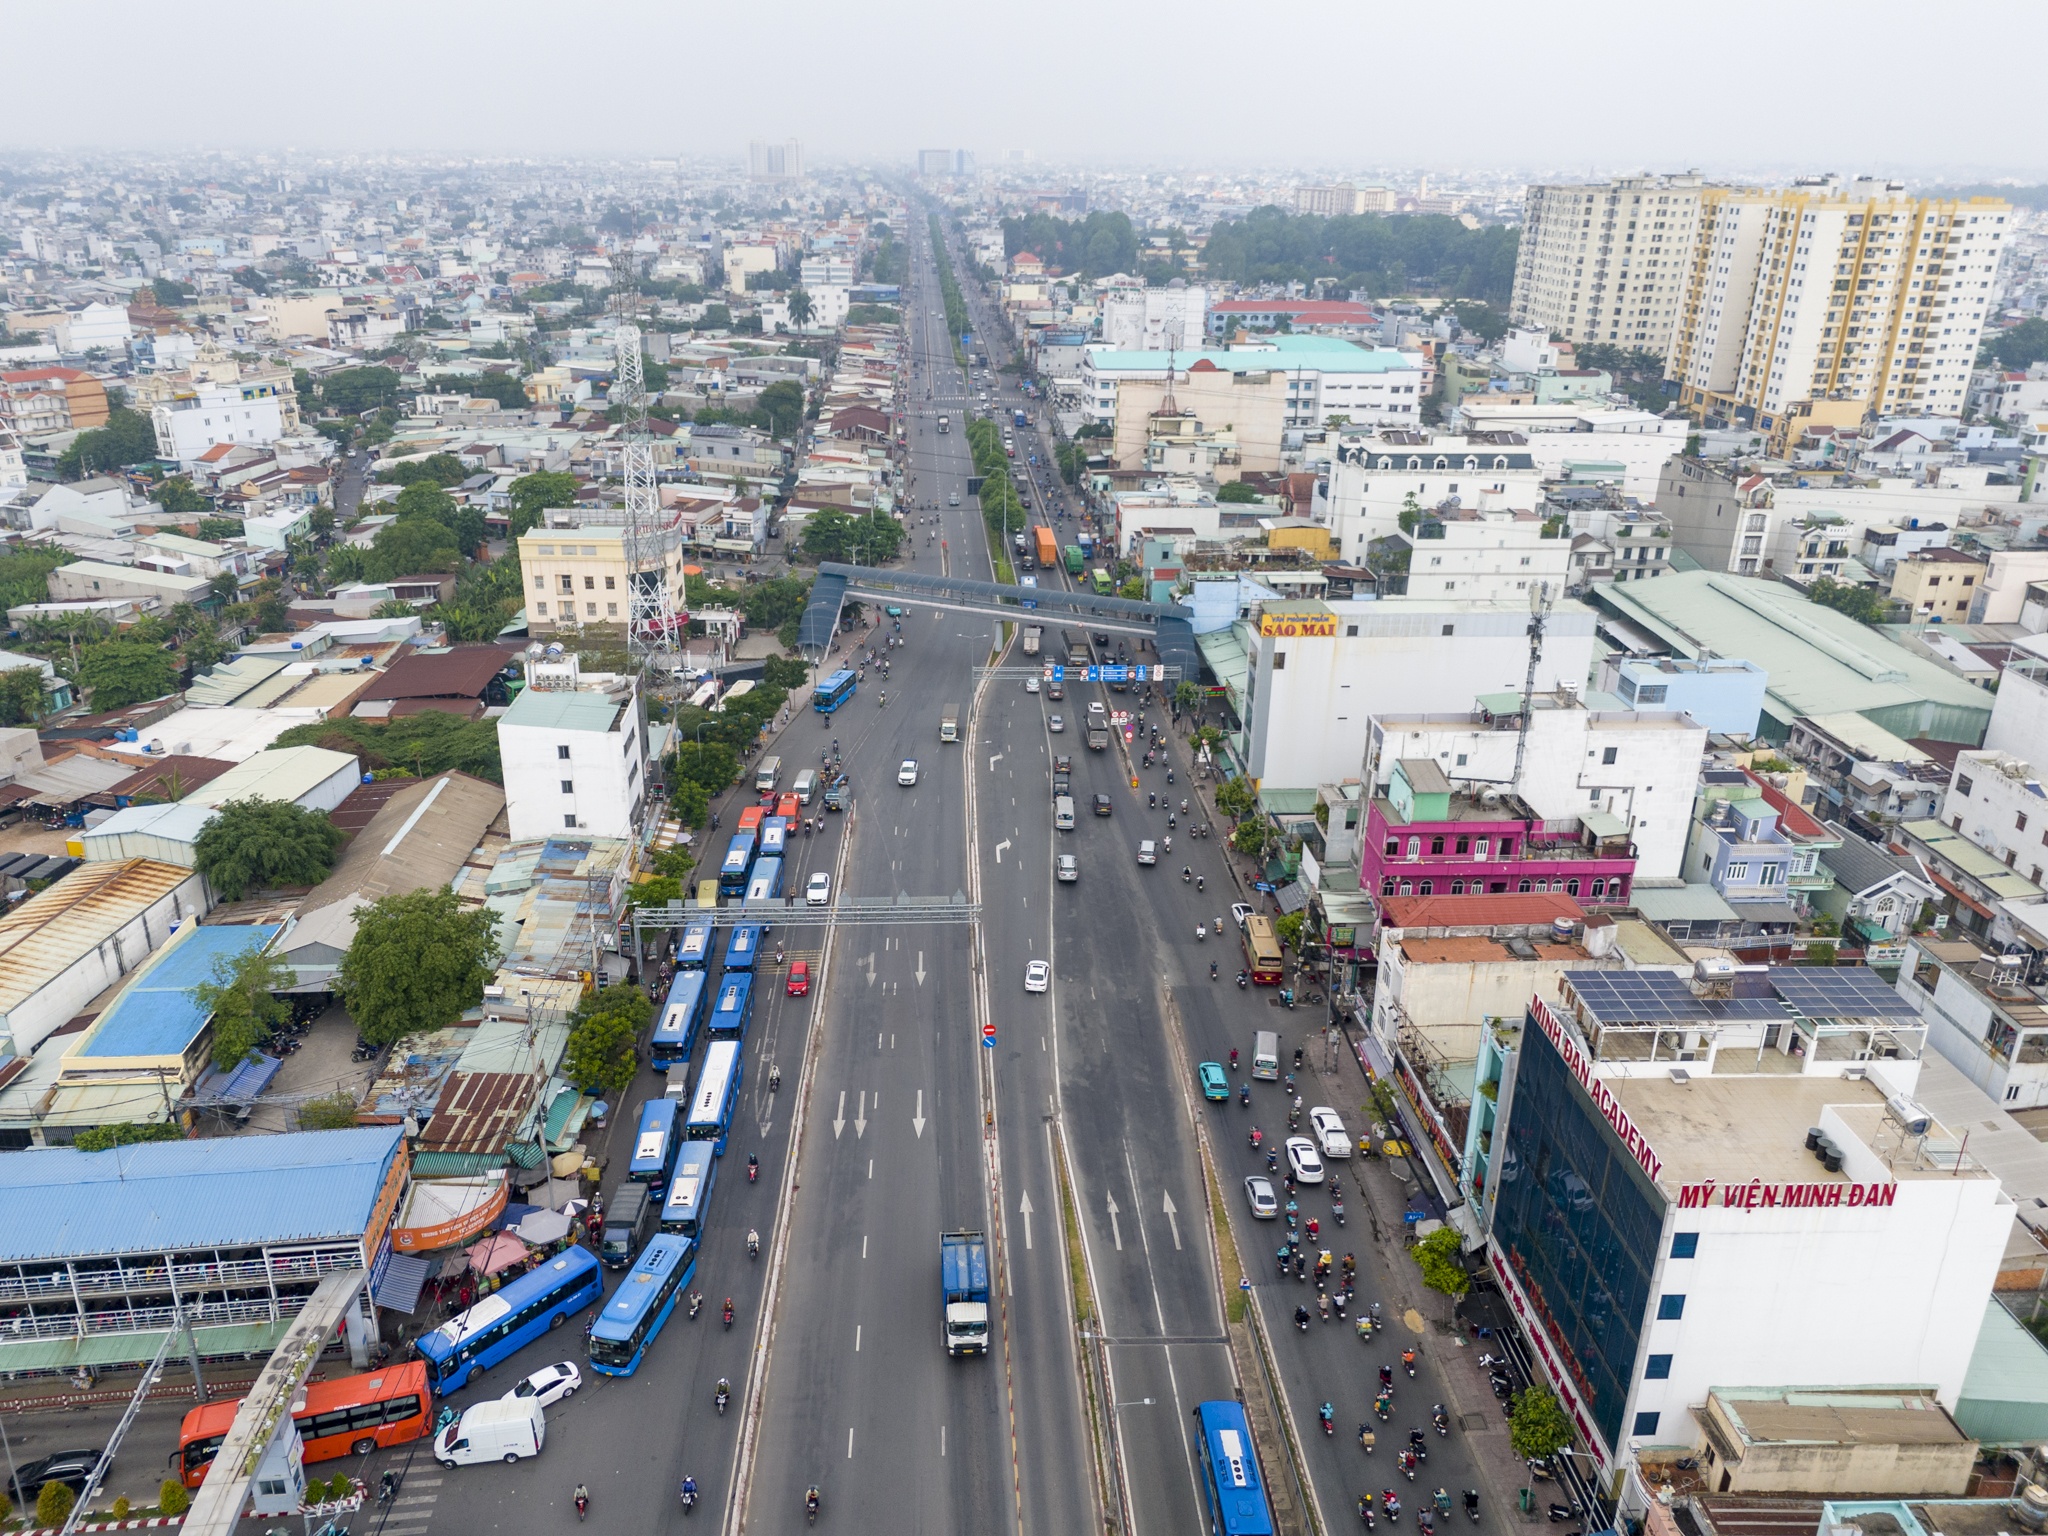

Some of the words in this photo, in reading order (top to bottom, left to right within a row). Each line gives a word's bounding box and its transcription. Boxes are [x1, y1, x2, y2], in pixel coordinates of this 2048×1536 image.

[1263, 623, 1297, 636] SAO
[1301, 624, 1335, 636] MAI
[1530, 992, 1563, 1049] MINH
[1563, 1038, 1592, 1089] ĐAN
[1591, 1078, 1663, 1183] ACADEMY
[1677, 1178, 1717, 1209] MỸ
[1722, 1177, 1779, 1214] VIỆN
[1781, 1183, 1843, 1208] MINH
[1847, 1183, 1898, 1208] ĐAN
